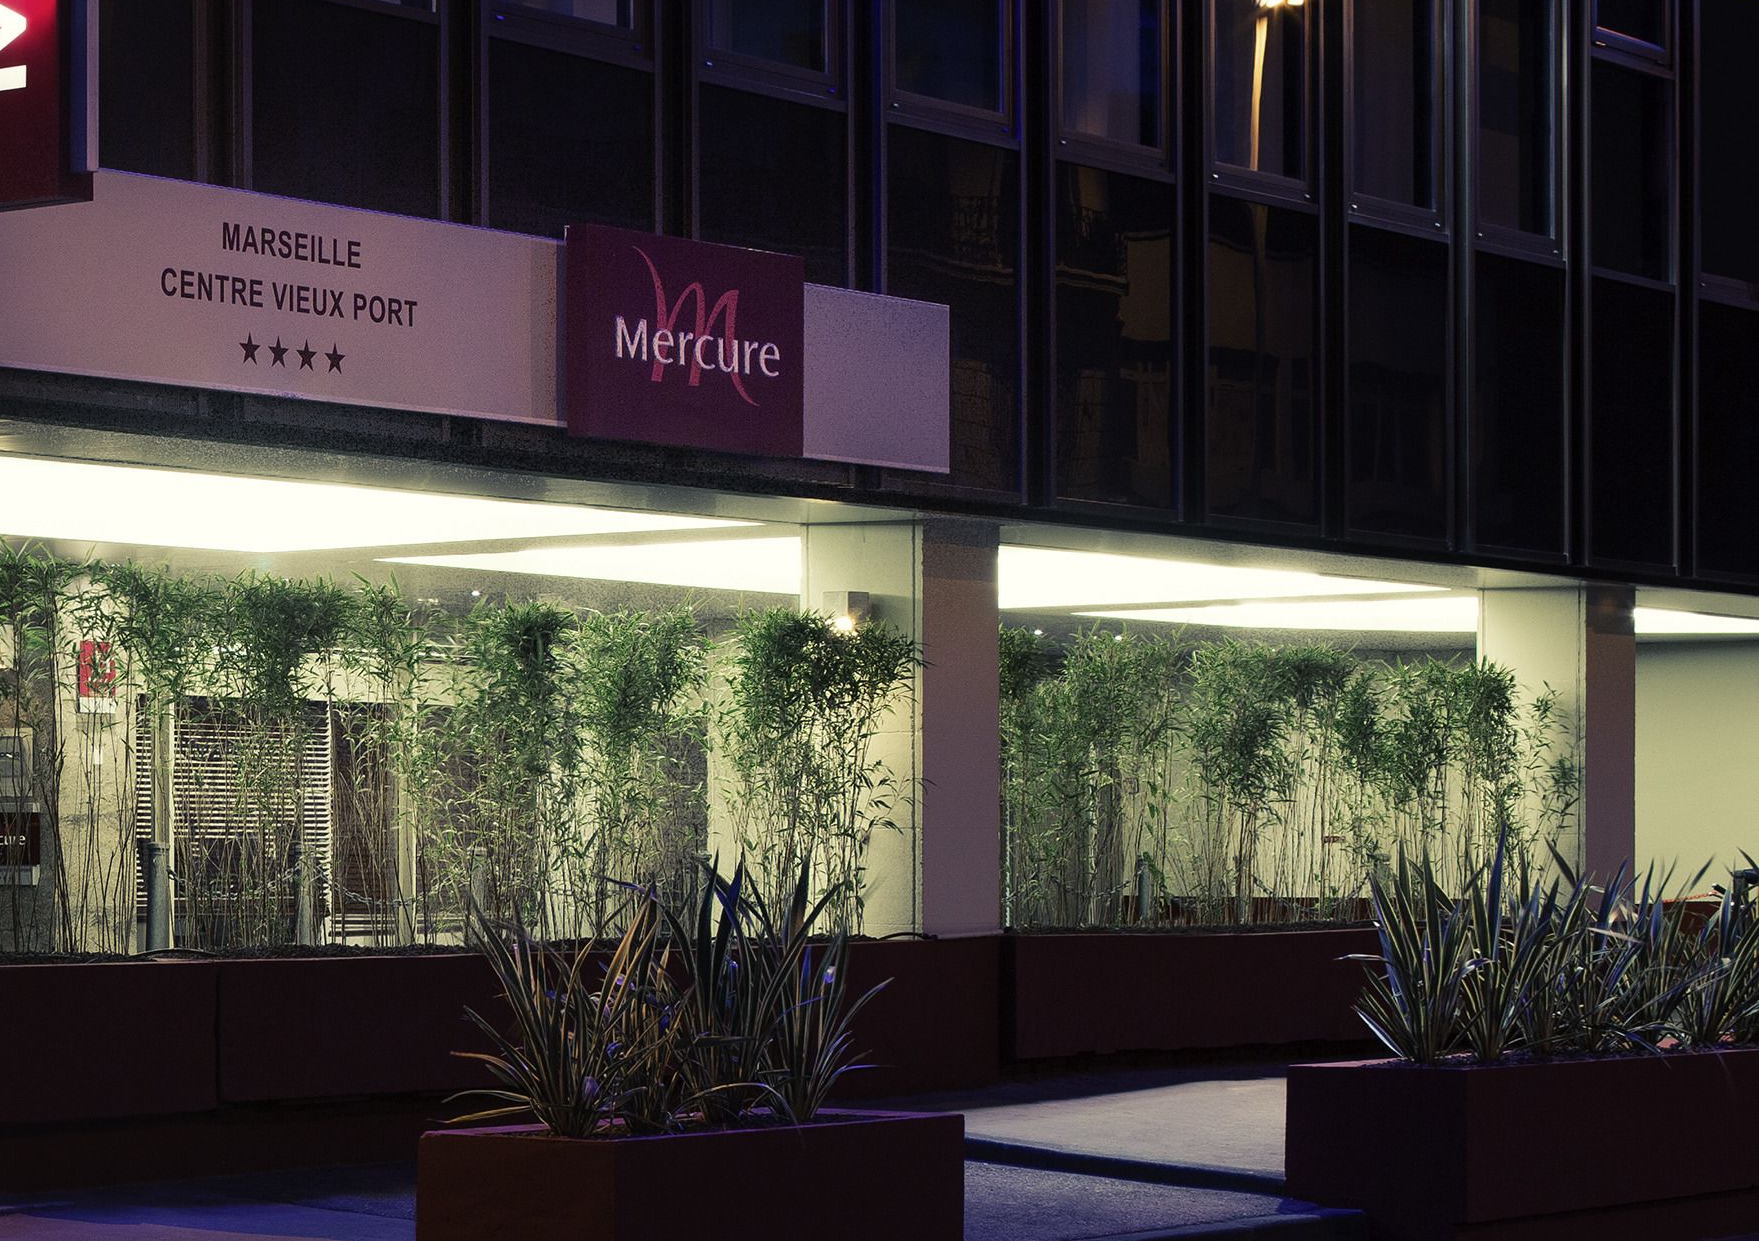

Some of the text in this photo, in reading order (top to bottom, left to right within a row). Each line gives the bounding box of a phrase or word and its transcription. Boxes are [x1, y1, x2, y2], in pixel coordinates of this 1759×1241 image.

[221, 221, 362, 269] MARSEILLE
[160, 267, 418, 328] CENTRE VIEUX PORT
[615, 314, 781, 378] Mercure
